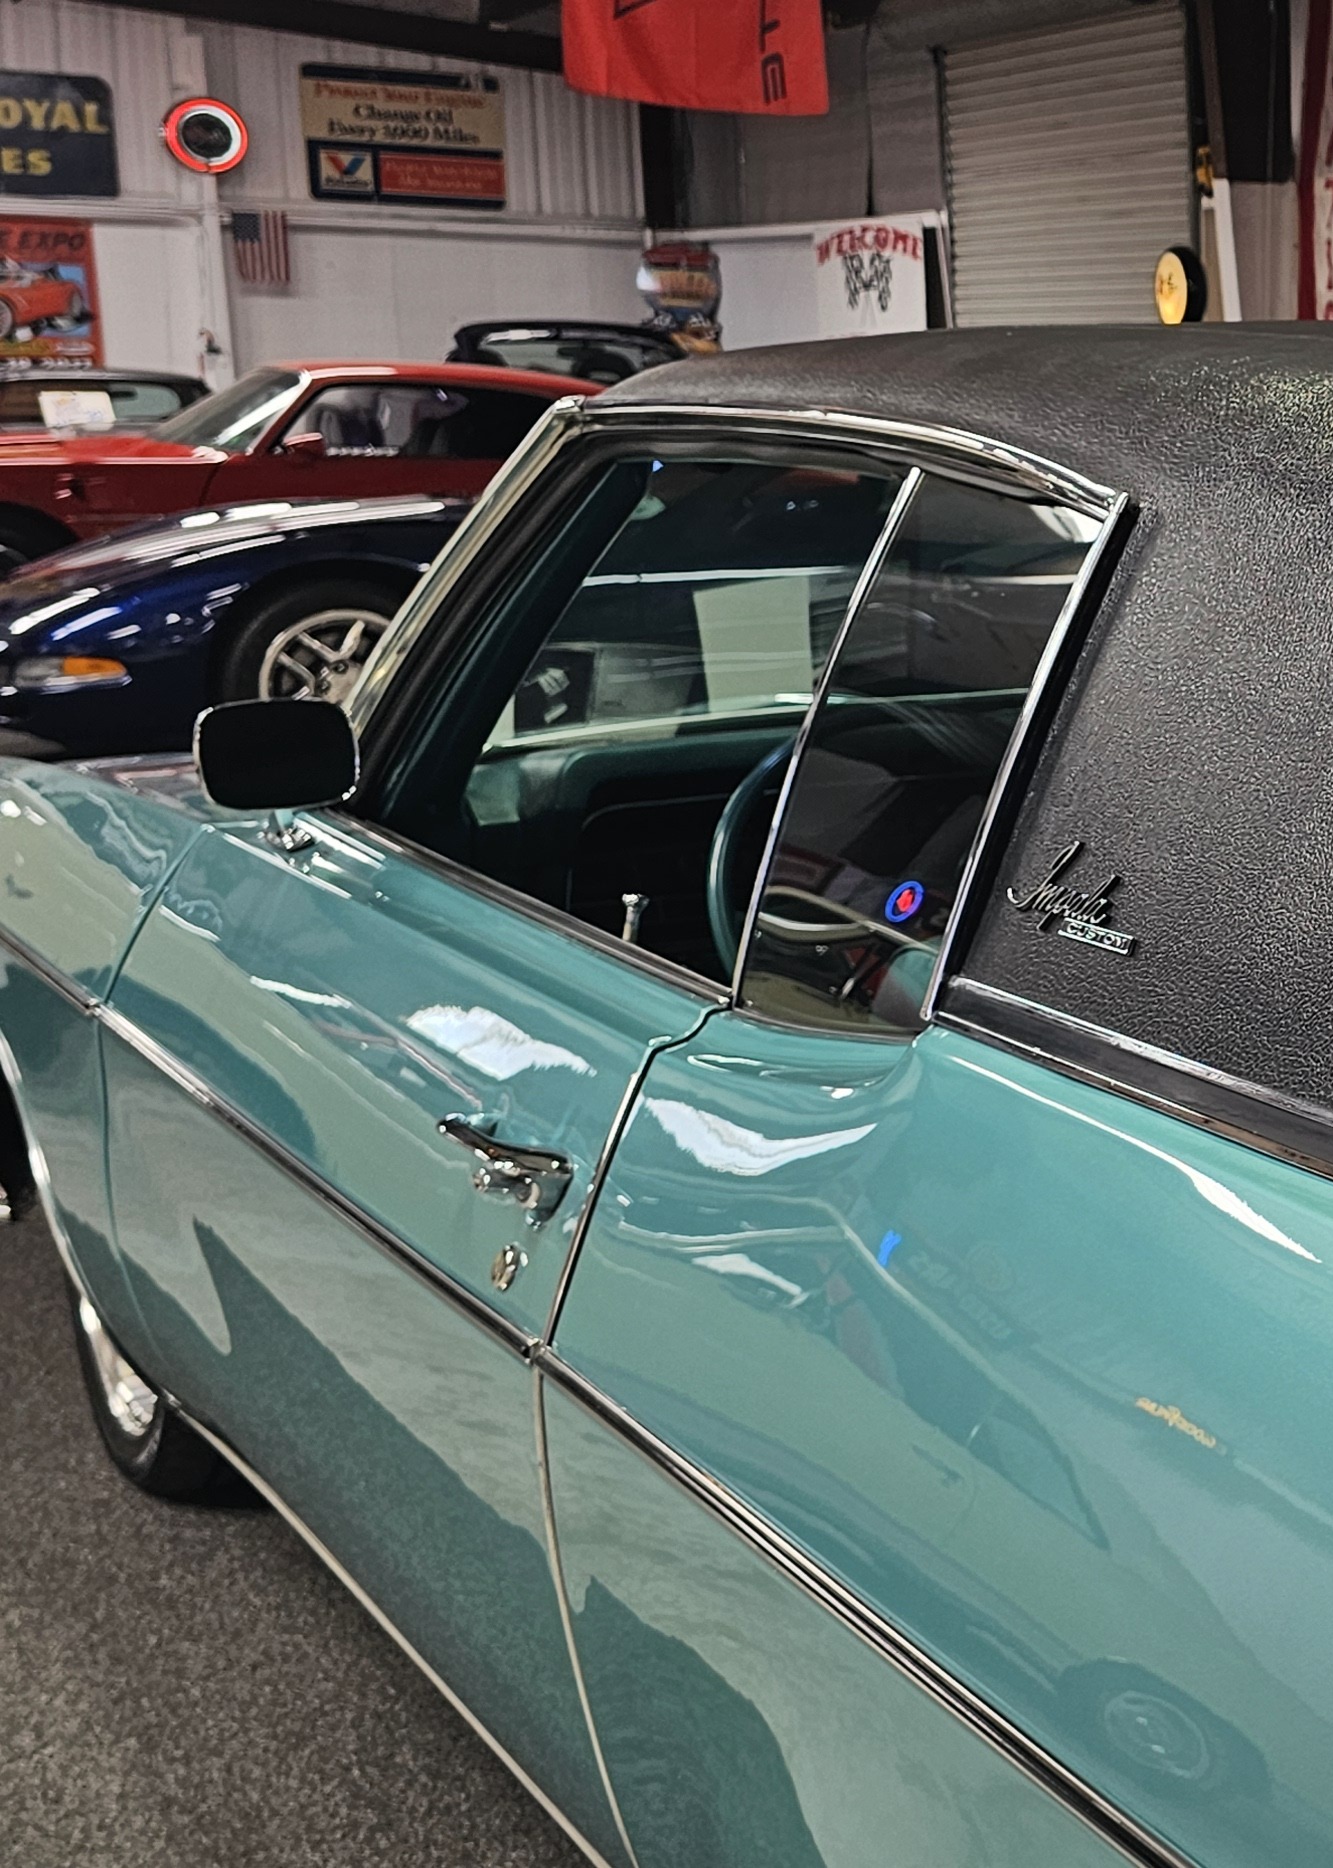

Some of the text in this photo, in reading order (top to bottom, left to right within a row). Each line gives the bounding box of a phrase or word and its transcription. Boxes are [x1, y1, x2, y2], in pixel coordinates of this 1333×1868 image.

[0, 97, 109, 134] OYAL
[20, 231, 85, 250] EXPO
[816, 225, 921, 267] WELCOME
[1007, 841, 1114, 931] Impala
[1066, 921, 1128, 948] CUSTOM
